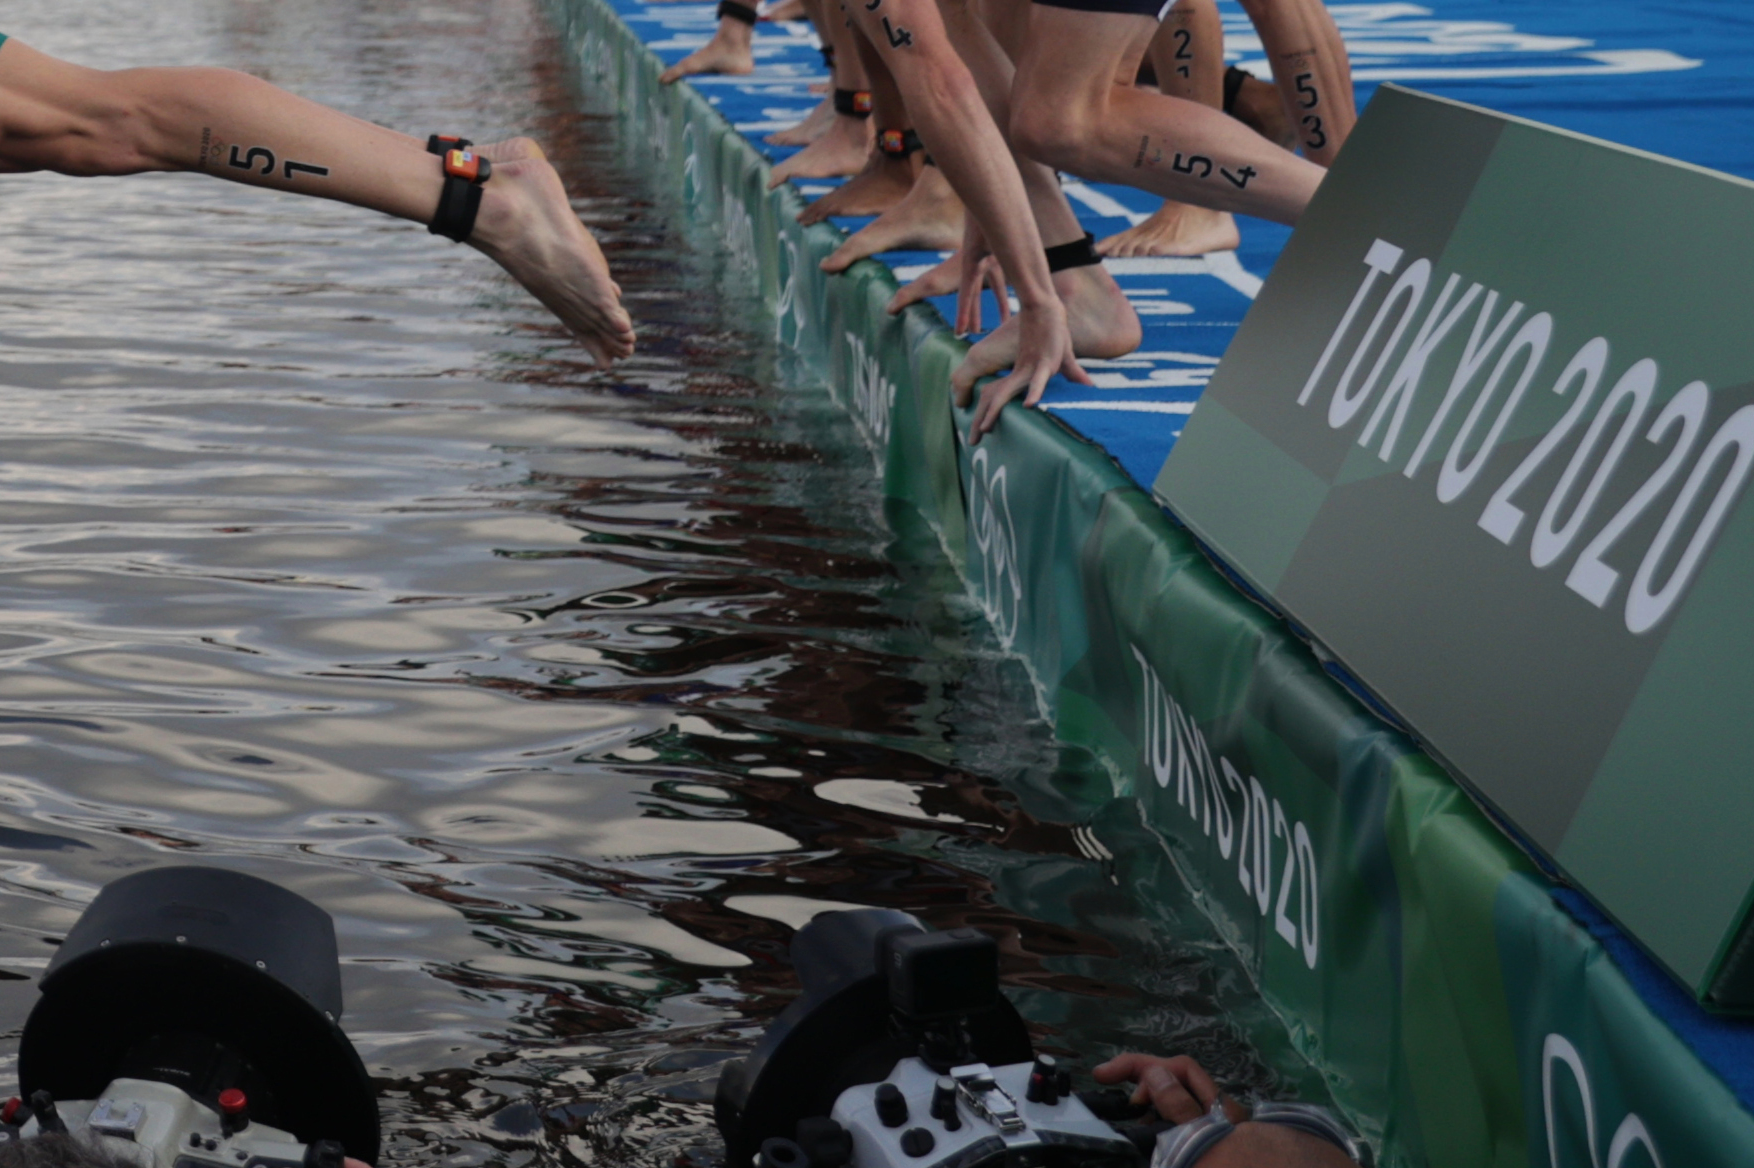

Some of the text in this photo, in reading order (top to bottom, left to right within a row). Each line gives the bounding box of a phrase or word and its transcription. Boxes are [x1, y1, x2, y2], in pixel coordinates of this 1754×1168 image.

[1296, 73, 1327, 149] 53
[228, 144, 329, 179] 51
[1172, 153, 1256, 189] 54
[1297, 239, 1754, 634] TOKYO 2020
[1130, 643, 1318, 970] TOKYO 2020
